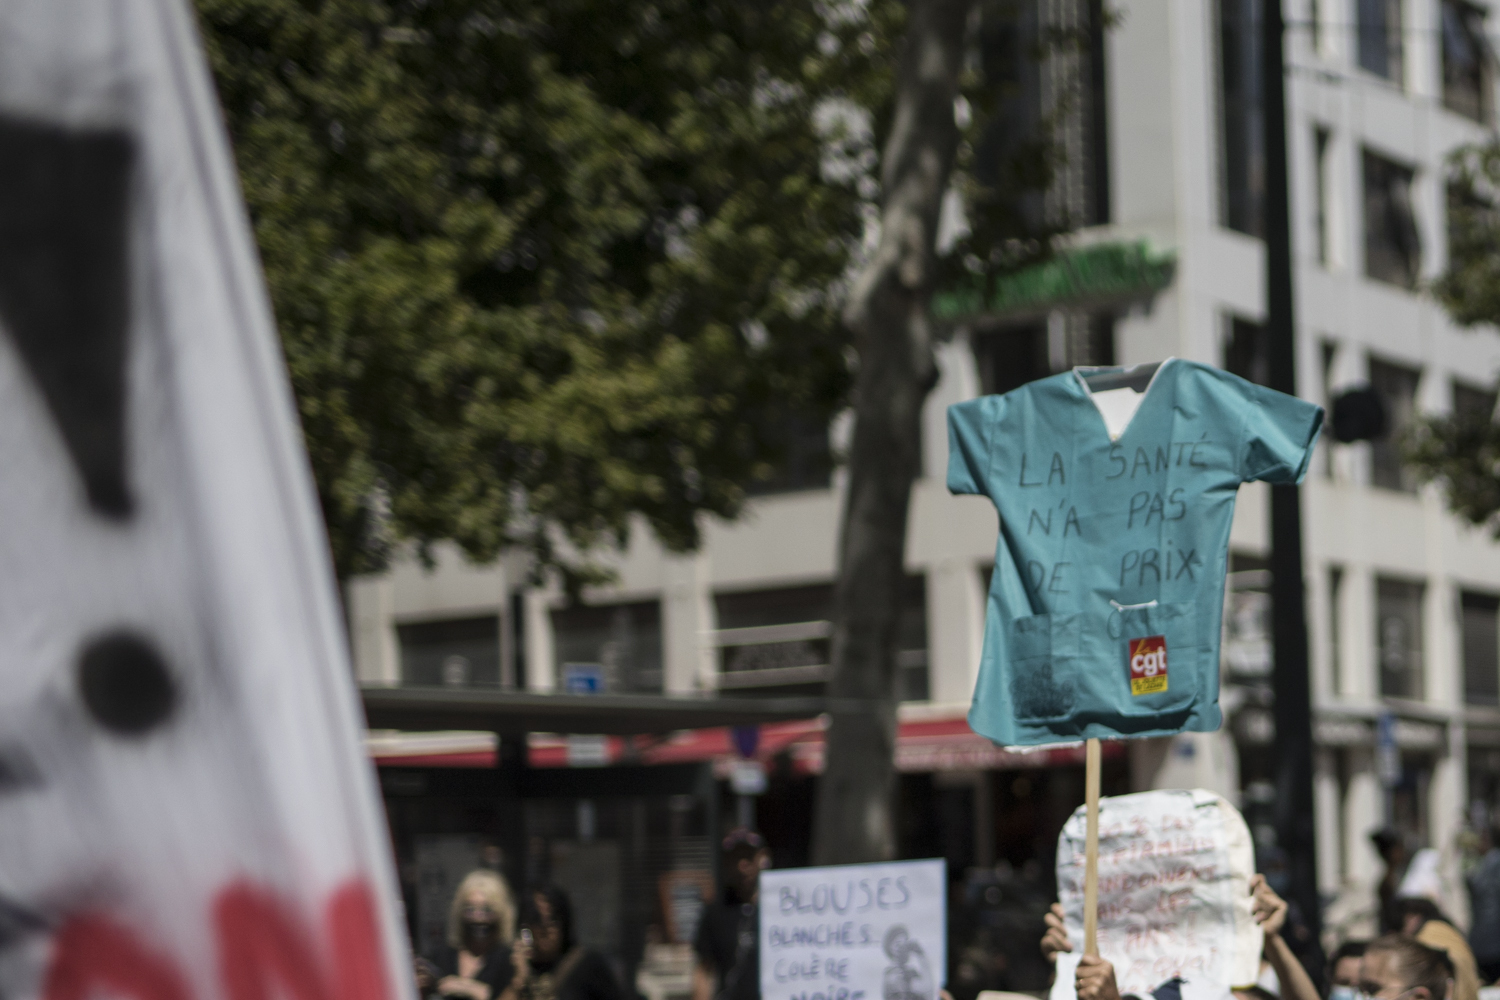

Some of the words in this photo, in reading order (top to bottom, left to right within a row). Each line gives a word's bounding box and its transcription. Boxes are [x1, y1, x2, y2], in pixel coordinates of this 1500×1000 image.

[1018, 451, 1066, 488] LA
[1105, 434, 1212, 480] SANTÉ
[1027, 498, 1082, 538] N'A
[1127, 488, 1187, 530] PAS
[1023, 561, 1072, 596] DE
[1131, 646, 1167, 676] cgt
[779, 876, 912, 915] BLOUSES
[773, 953, 849, 983] COLÈRE
